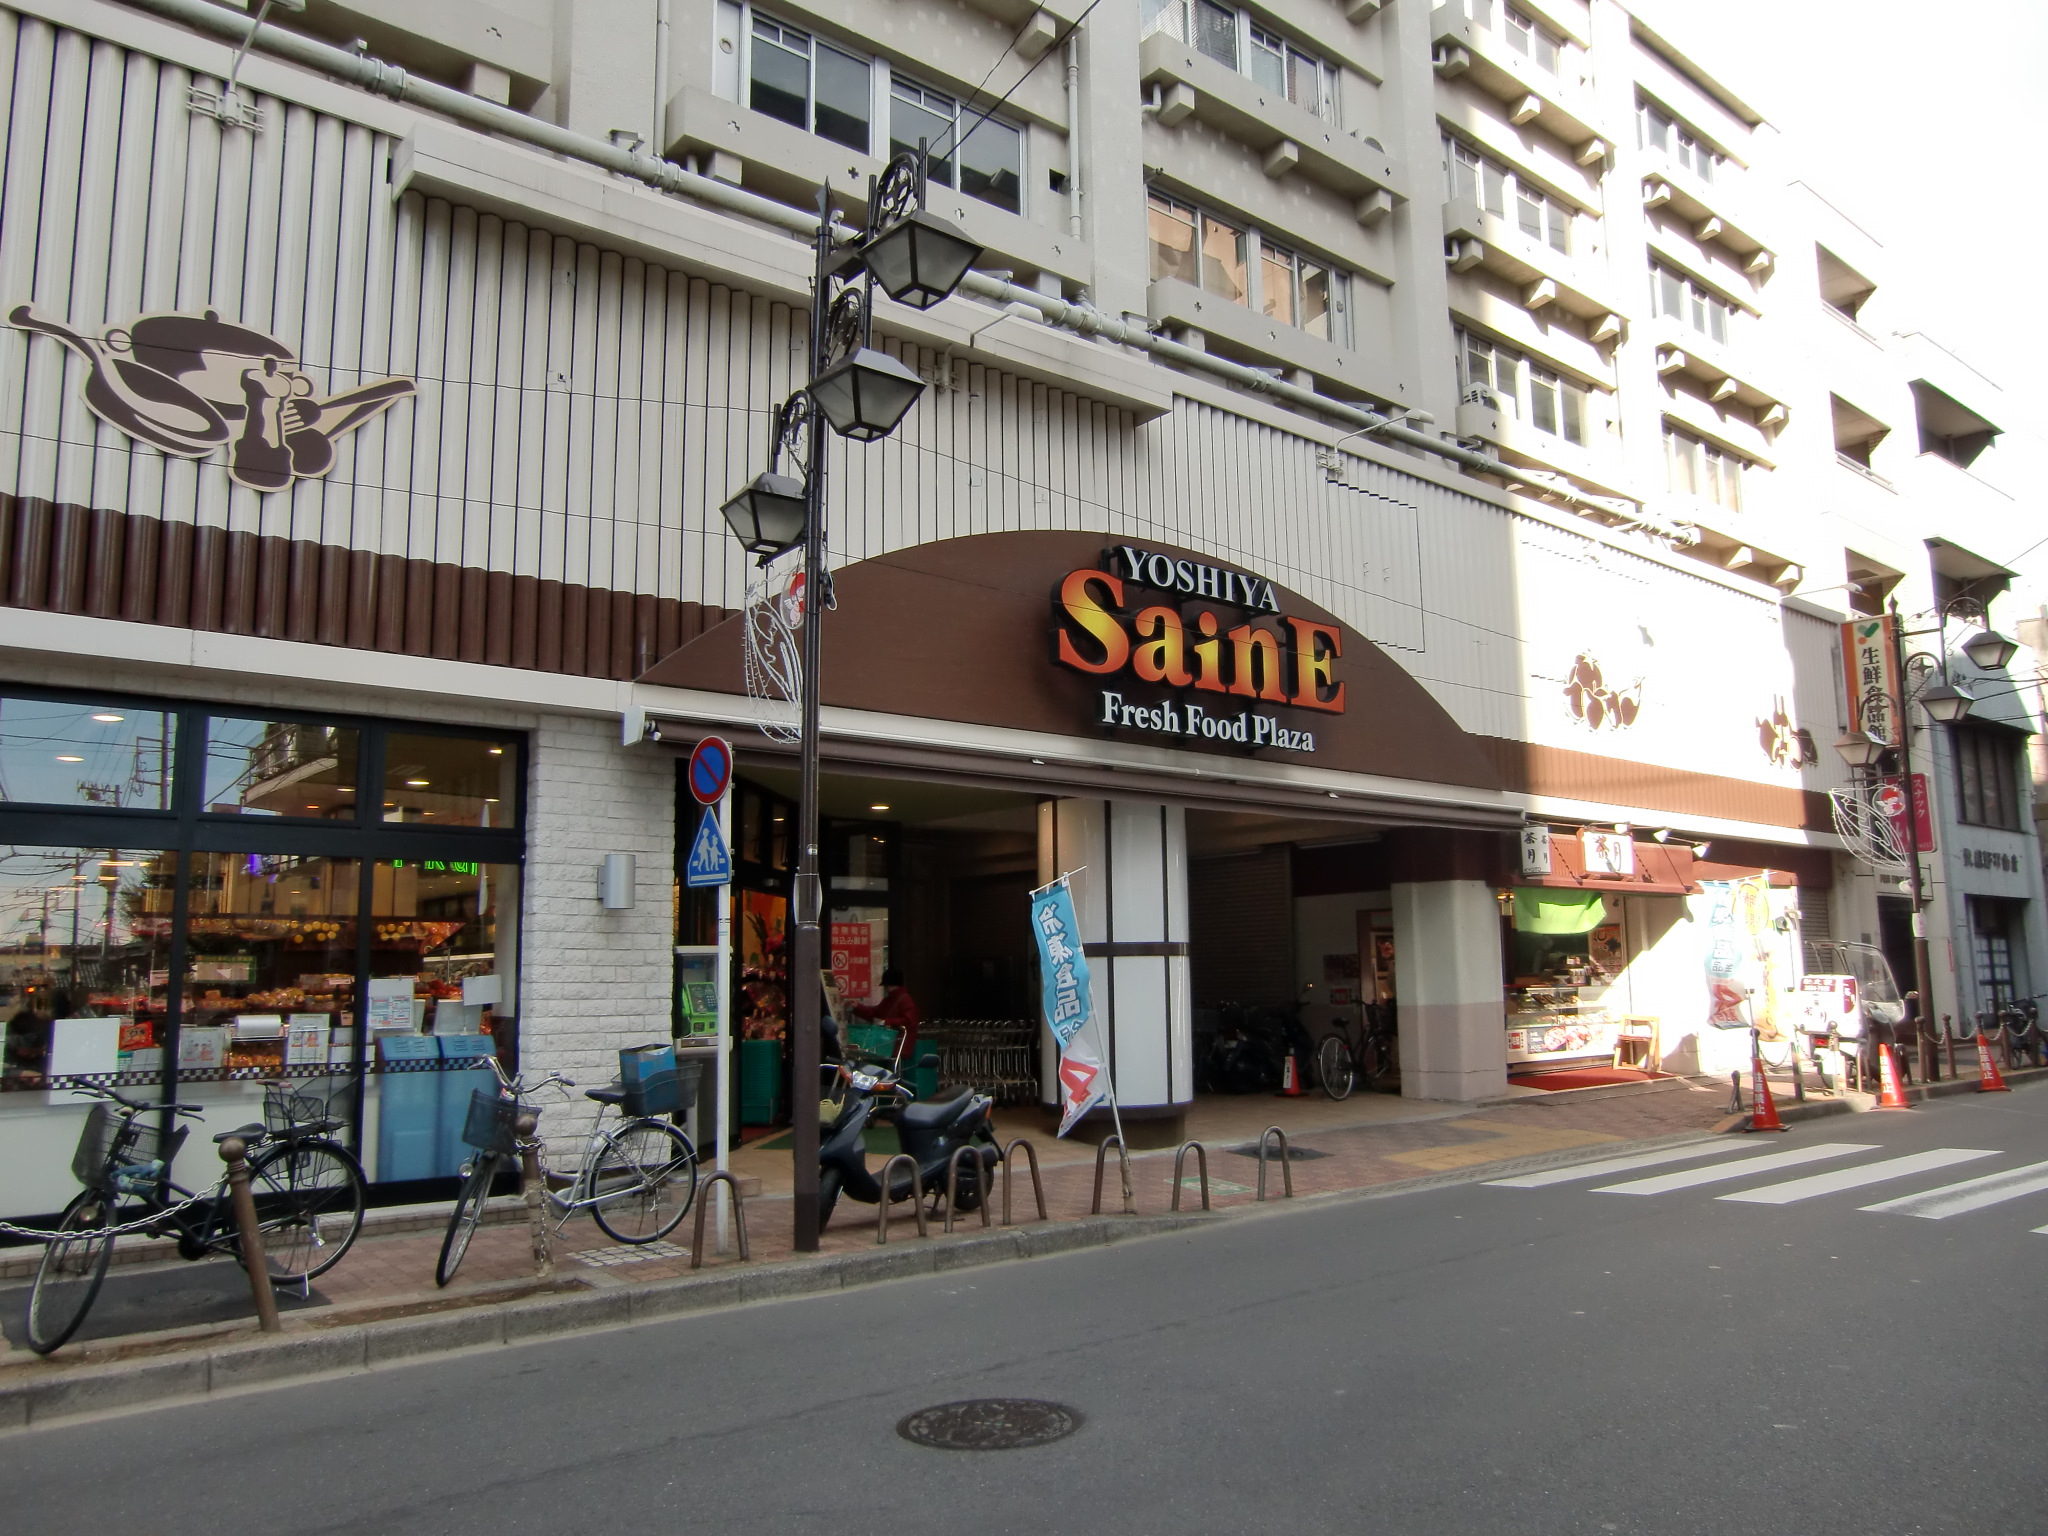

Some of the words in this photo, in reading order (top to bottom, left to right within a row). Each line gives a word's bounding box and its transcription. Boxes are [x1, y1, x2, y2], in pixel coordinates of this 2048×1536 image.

[1121, 545, 1281, 613] YOSHIYA
[1058, 569, 1345, 715] SainE
[1102, 691, 1180, 733] Fresh
[1185, 704, 1249, 743] Food
[1252, 714, 1315, 752] Plaza
[1524, 831, 1537, 864] 茶月
